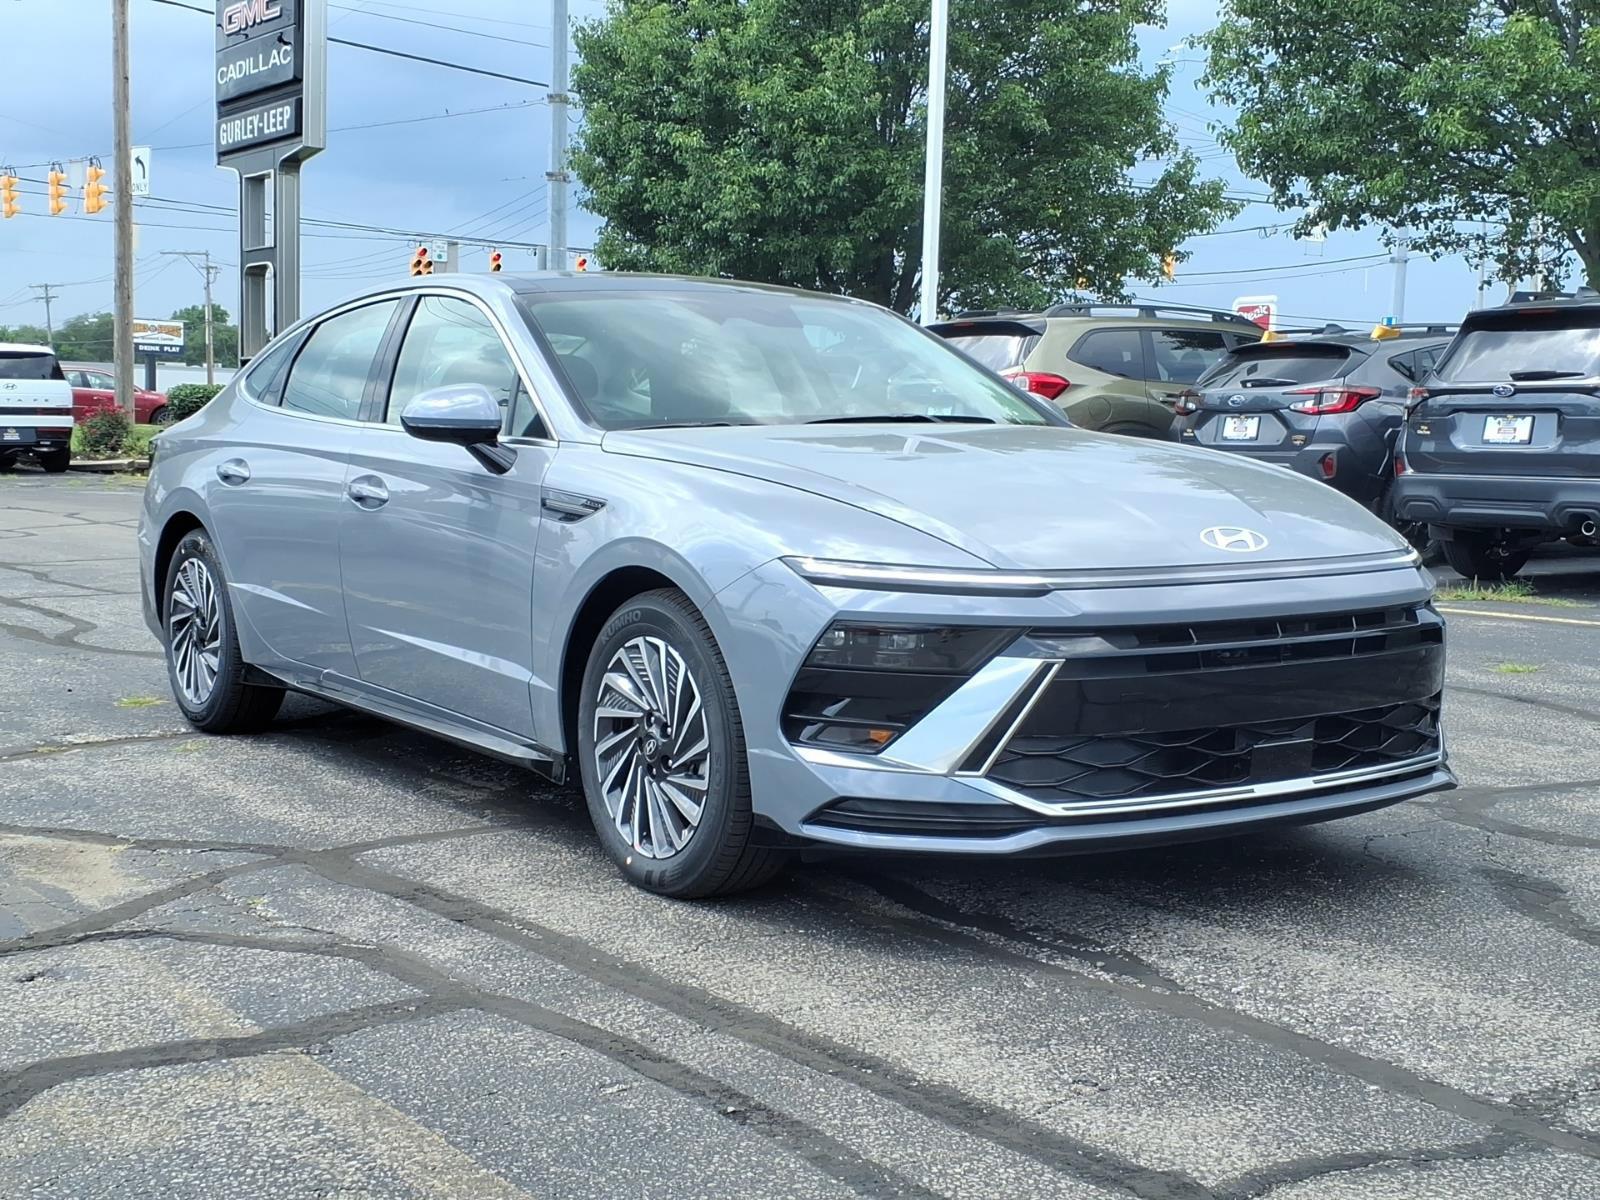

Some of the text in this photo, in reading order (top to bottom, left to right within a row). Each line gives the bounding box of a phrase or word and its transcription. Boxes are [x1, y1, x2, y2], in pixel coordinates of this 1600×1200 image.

[223, 0, 281, 35] GMC
[217, 46, 292, 85] CADILLAC
[219, 105, 291, 145] GURLEY-LEEP
[600, 610, 641, 645] KUMHO
